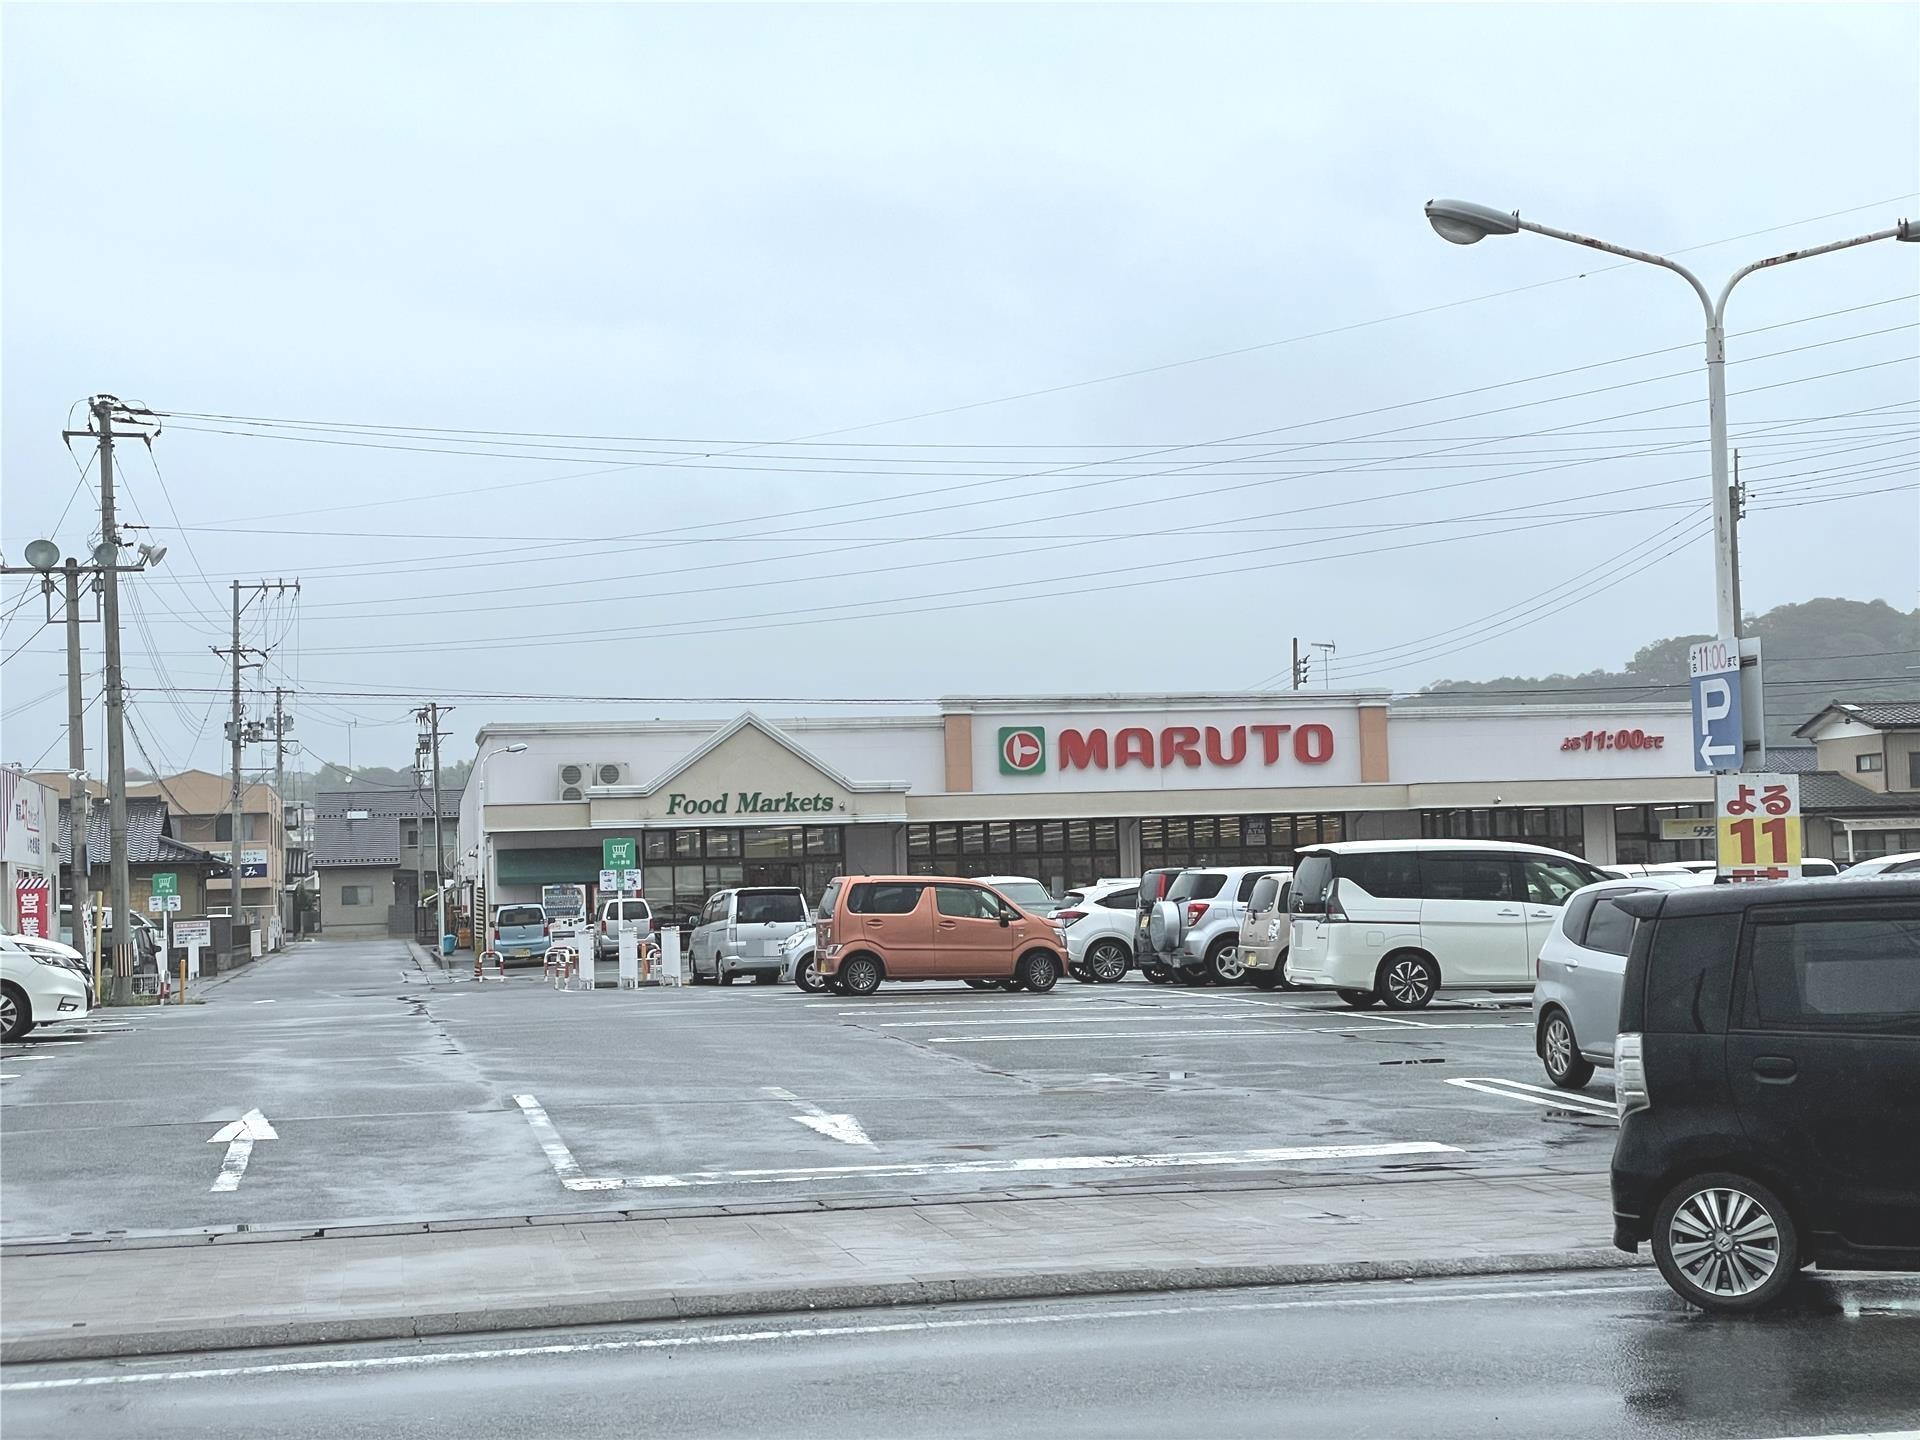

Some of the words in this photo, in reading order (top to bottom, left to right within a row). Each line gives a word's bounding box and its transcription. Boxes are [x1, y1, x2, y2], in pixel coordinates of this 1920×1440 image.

[1700, 678, 1731, 735] P
[1059, 724, 1334, 771] MARUTO
[1561, 730, 1664, 751] よる11:00まで
[666, 793, 728, 814] Food
[735, 792, 833, 813] Markets
[1727, 784, 1791, 815] よる
[1730, 818, 1788, 864] 11
